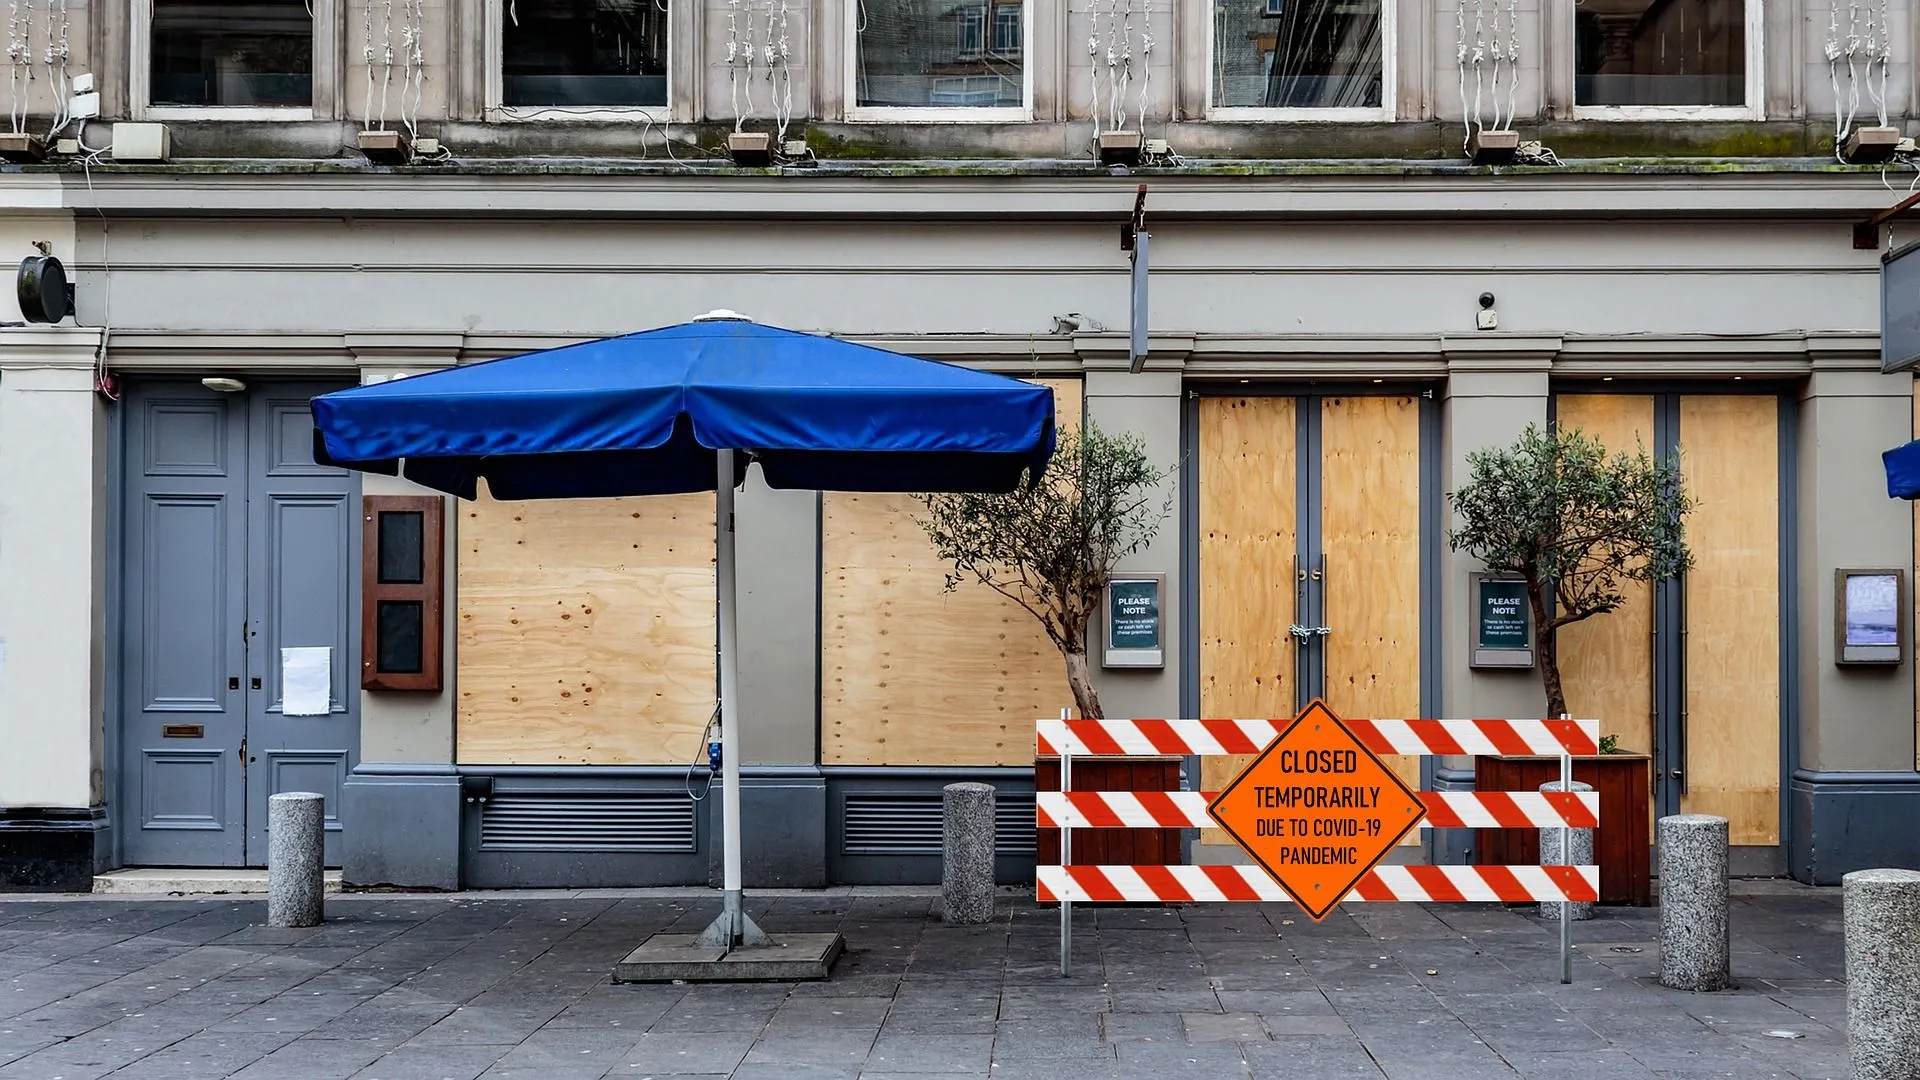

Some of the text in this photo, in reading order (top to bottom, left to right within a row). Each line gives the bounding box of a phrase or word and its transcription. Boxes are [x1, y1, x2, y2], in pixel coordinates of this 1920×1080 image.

[1118, 597, 1150, 605] PLEASE
[1487, 597, 1521, 605] PLEASE
[1492, 607, 1516, 615] NOTE
[1280, 749, 1357, 774] CLOSED
[1253, 786, 1381, 808] TEMPORARILY
[1256, 818, 1381, 837] DUE TO COVID-19
[1280, 846, 1357, 865] PANDEMIC
